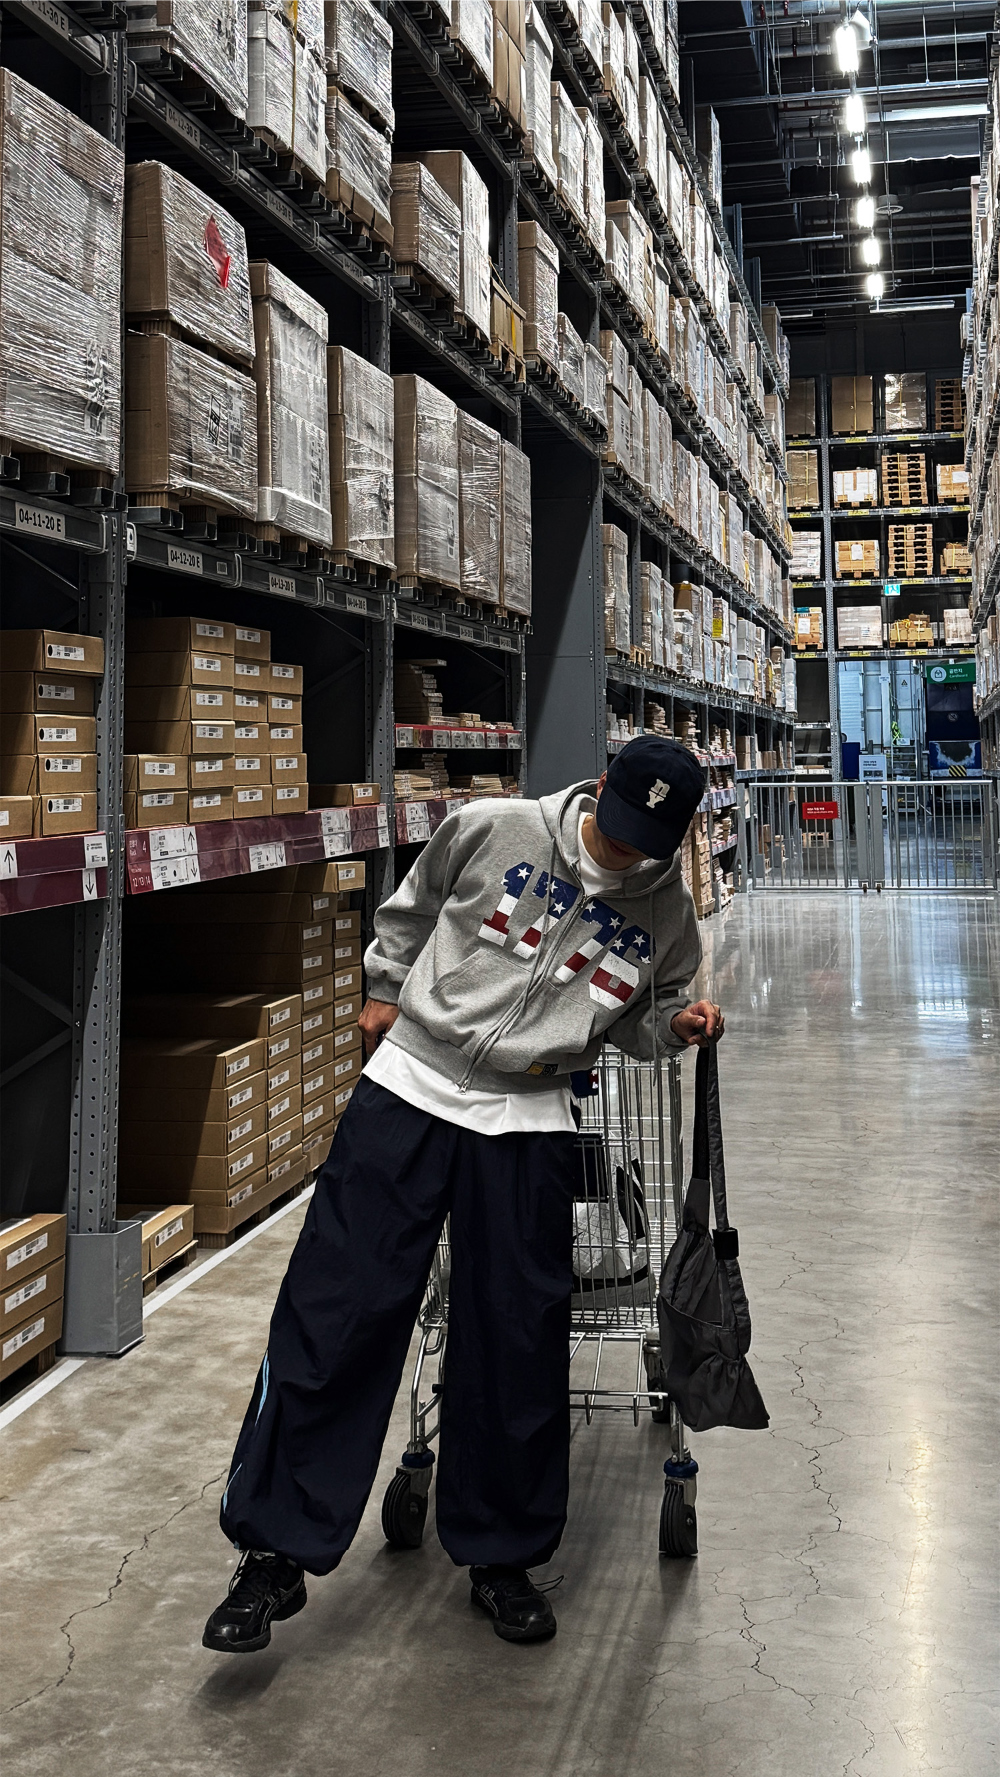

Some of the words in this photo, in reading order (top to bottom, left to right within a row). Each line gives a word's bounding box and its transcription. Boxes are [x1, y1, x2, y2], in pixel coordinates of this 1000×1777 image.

[61, 16, 65, 31] E
[168, 108, 193, 138] 04-12-30
[193, 131, 198, 142] E
[19, 508, 55, 531] 04-11-20
[57, 518, 61, 532] E
[170, 549, 195, 567] 04-12-20
[196, 555, 200, 568] E
[142, 840, 147, 853] 4
[477, 861, 657, 1011] 1776
